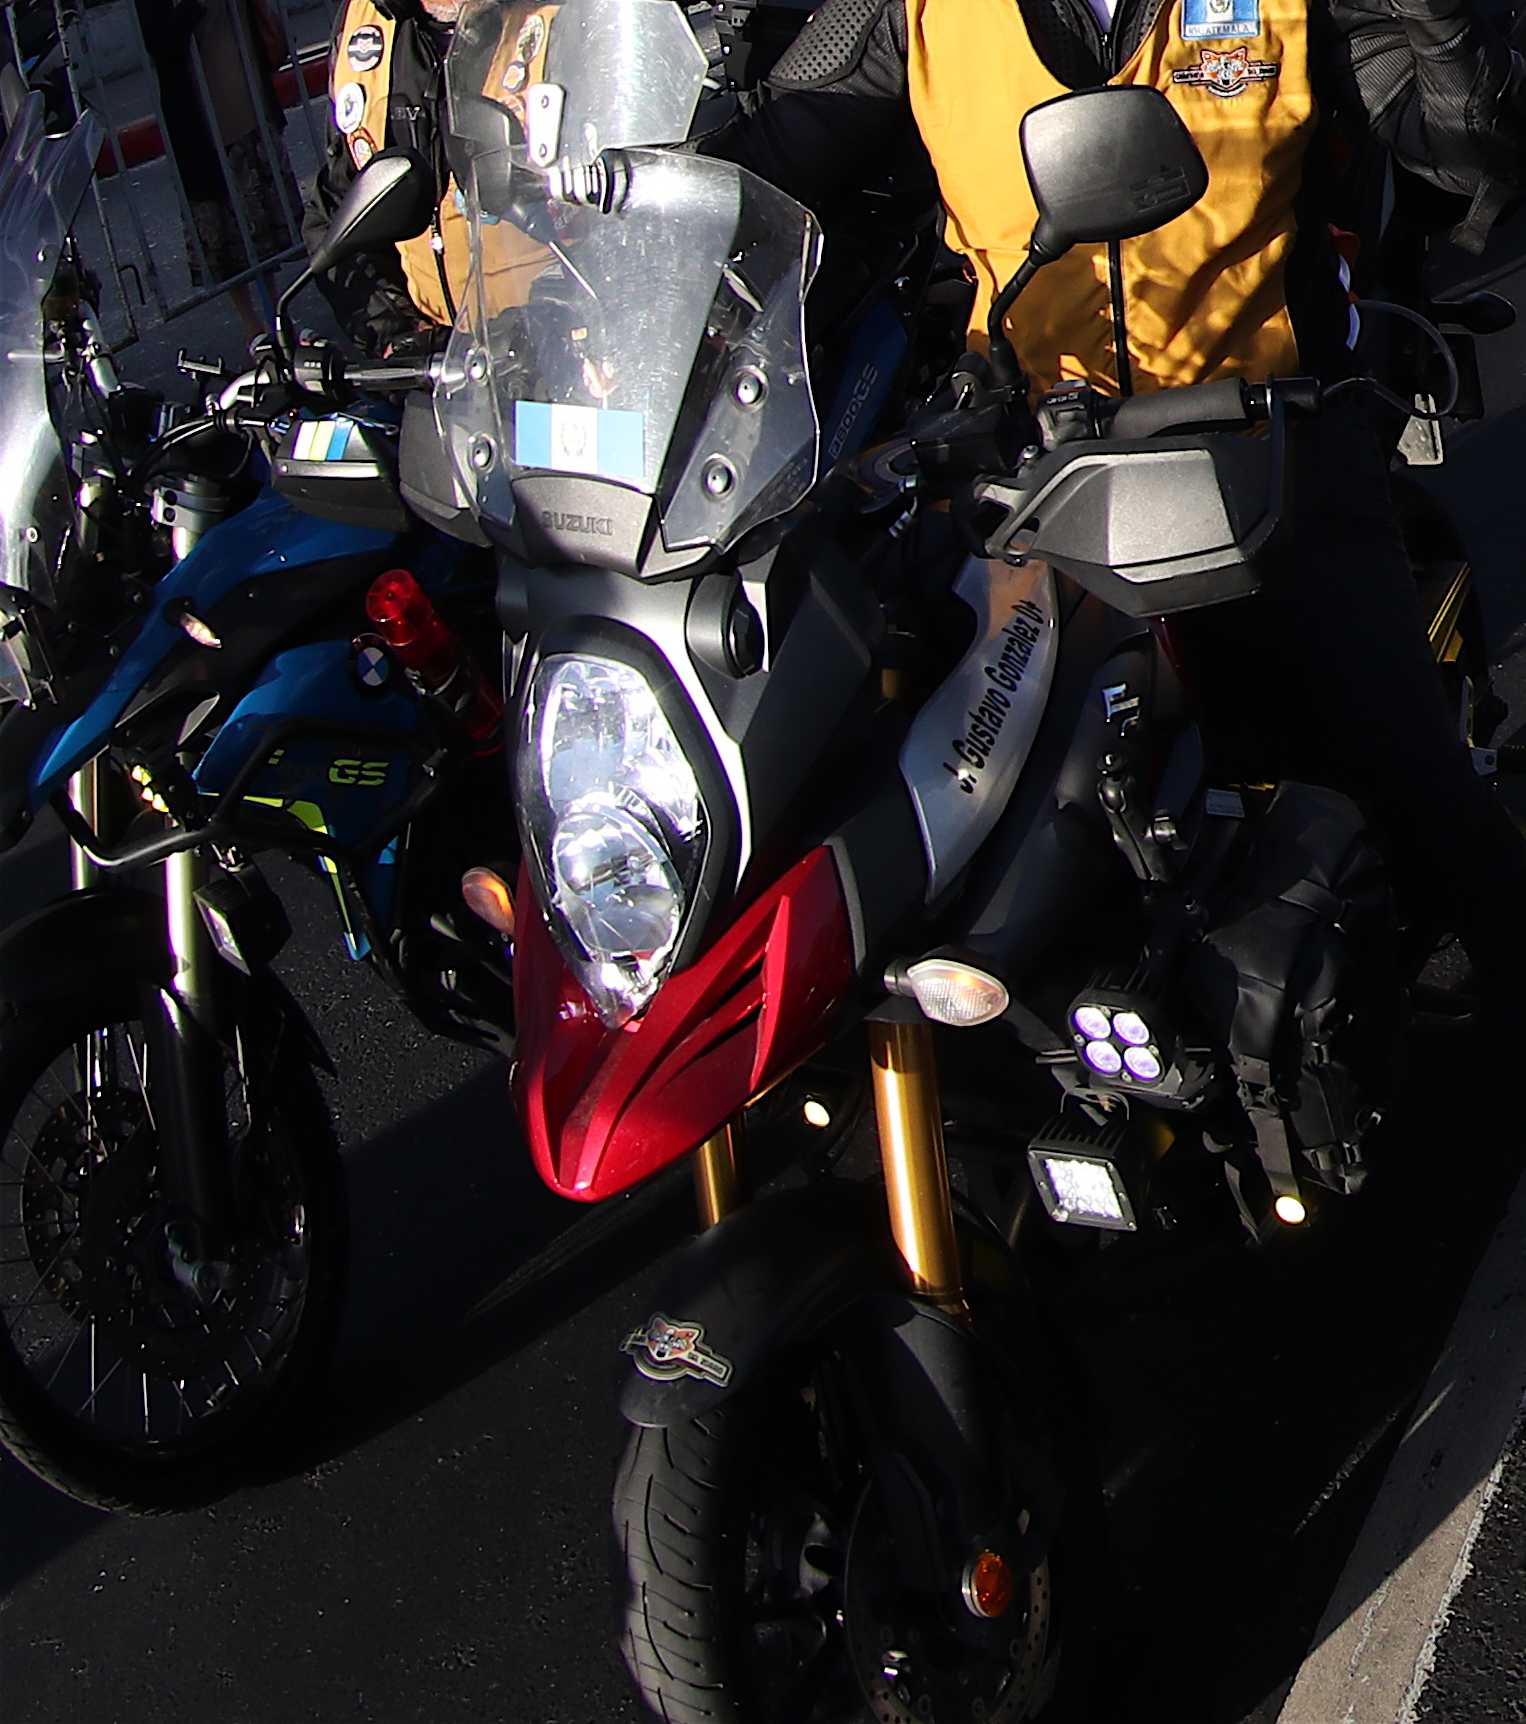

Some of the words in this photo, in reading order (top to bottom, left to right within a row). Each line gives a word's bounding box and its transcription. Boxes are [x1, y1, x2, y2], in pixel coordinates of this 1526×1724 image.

[1188, 25, 1250, 35] GUATEMALA
[541, 509, 614, 536] SUZUKI
[951, 687, 1011, 769] Gustavo
[984, 616, 1041, 692] Gonzalez
[328, 759, 389, 786] GS
